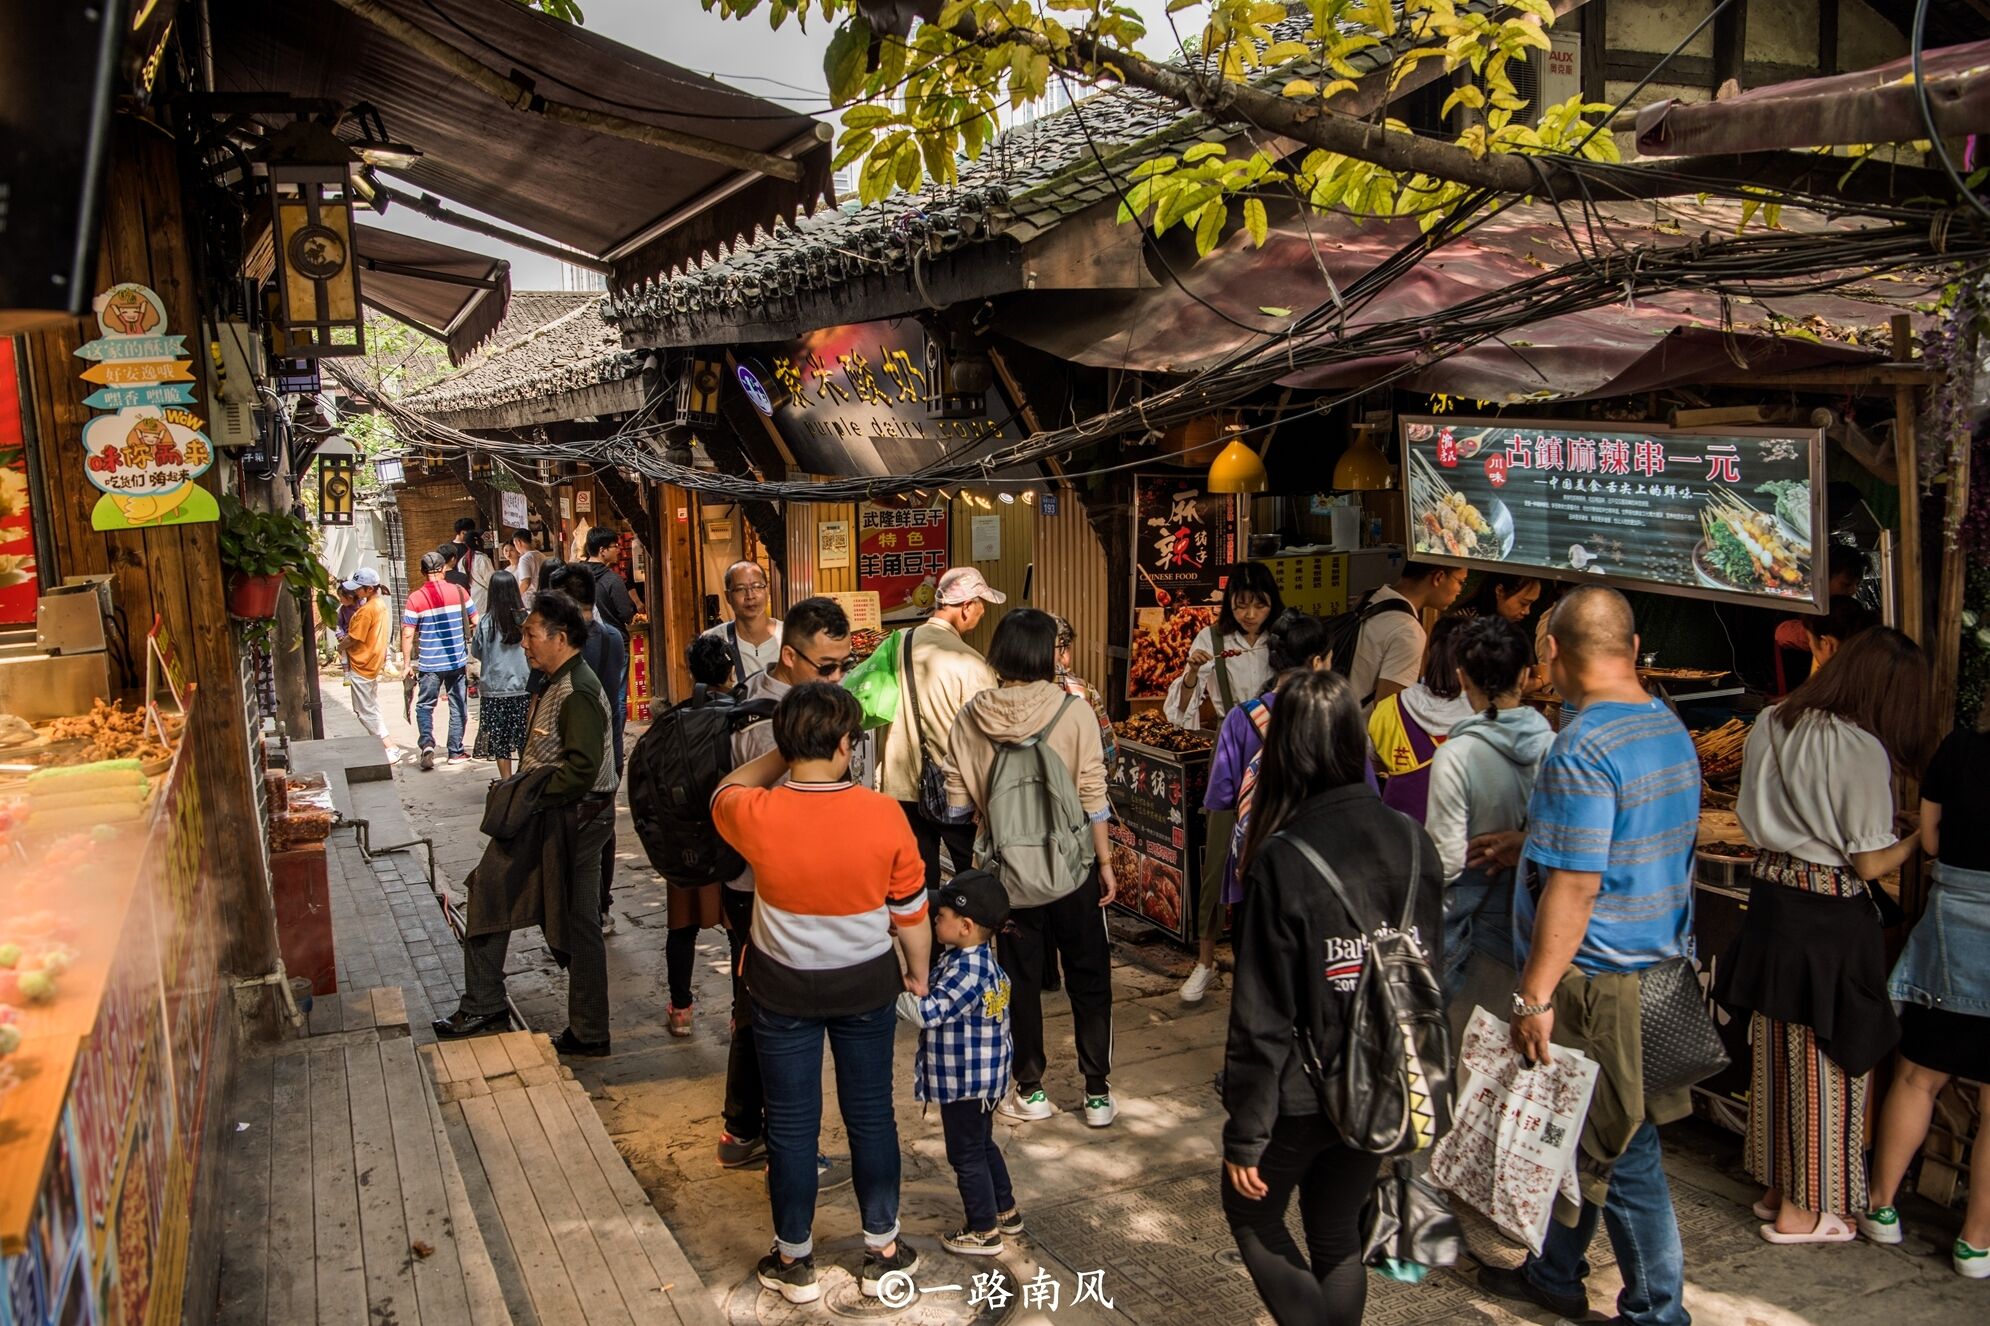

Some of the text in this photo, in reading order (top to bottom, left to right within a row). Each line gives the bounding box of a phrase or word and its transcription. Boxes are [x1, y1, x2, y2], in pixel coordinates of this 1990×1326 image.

[1549, 51, 1573, 62] AUX
[1550, 64, 1572, 75] 奥克斯
[86, 339, 182, 360] 这家的酥肉
[771, 345, 927, 409] 紫米酸奶
[804, 417, 864, 440] purple
[870, 416, 926, 440] dairy
[1488, 457, 1507, 483] 川味
[863, 508, 945, 529] 武隆鲜豆干
[1043, 504, 1056, 514] 193
[860, 551, 946, 578] 羊角豆干
[1175, 572, 1198, 580] FOOD
